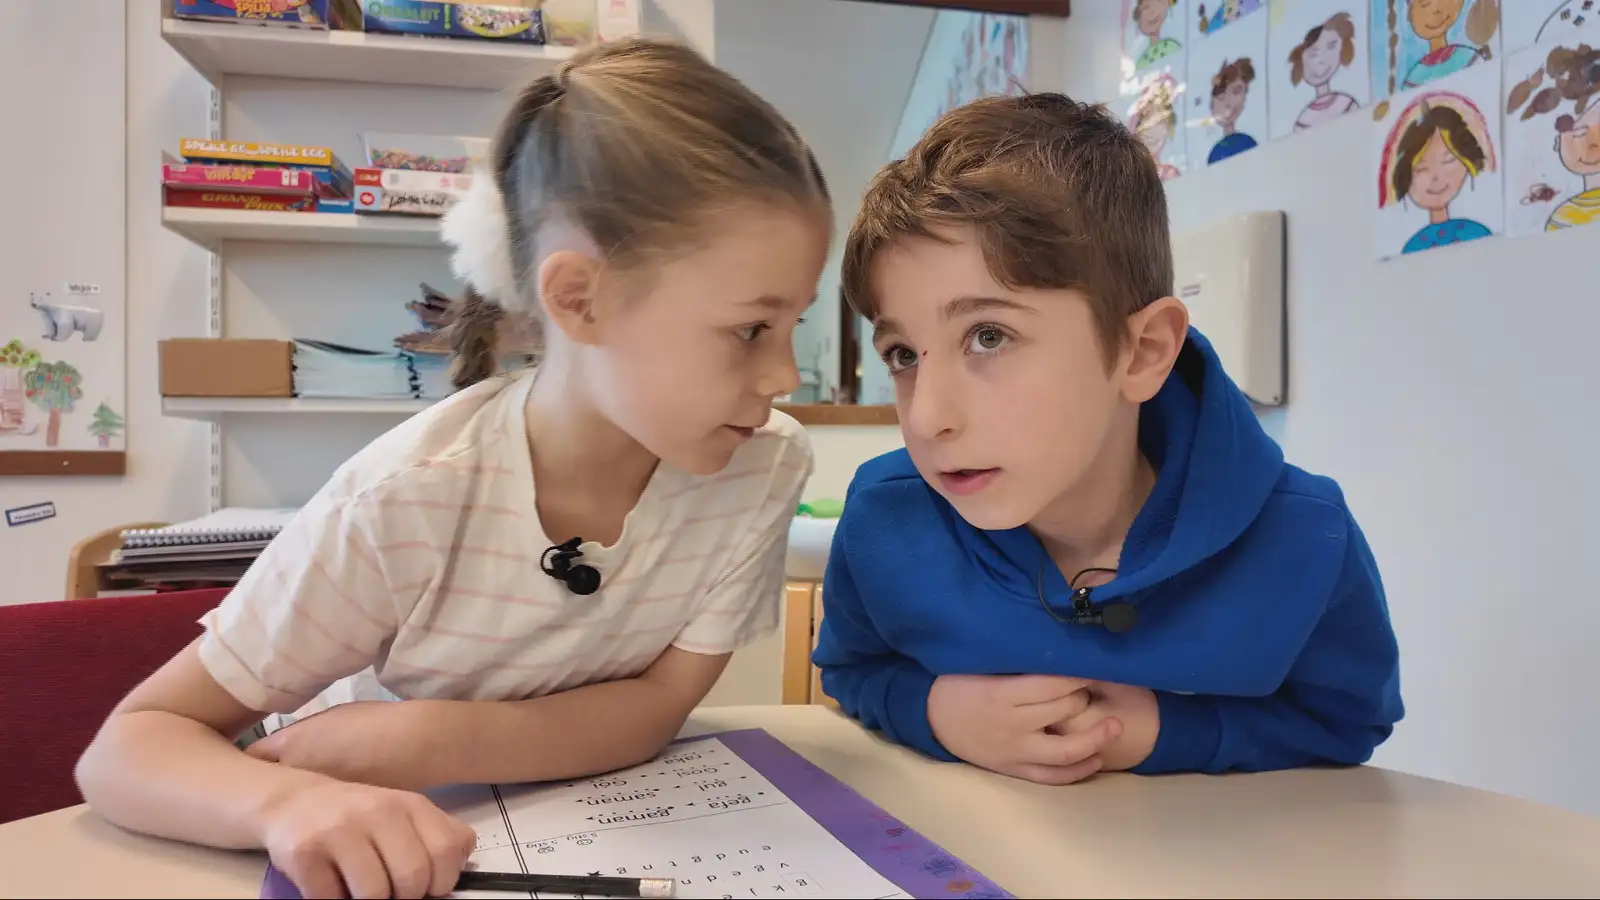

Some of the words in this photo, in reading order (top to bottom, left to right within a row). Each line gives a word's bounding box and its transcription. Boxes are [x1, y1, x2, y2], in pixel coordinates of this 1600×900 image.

[664, 754, 702, 764] raka
[677, 766, 717, 777] Gosi
[593, 779, 627, 789] Gói
[698, 780, 727, 792] gul
[587, 791, 657, 806] saman
[708, 795, 751, 809] gefa
[598, 808, 670, 825] gaman
